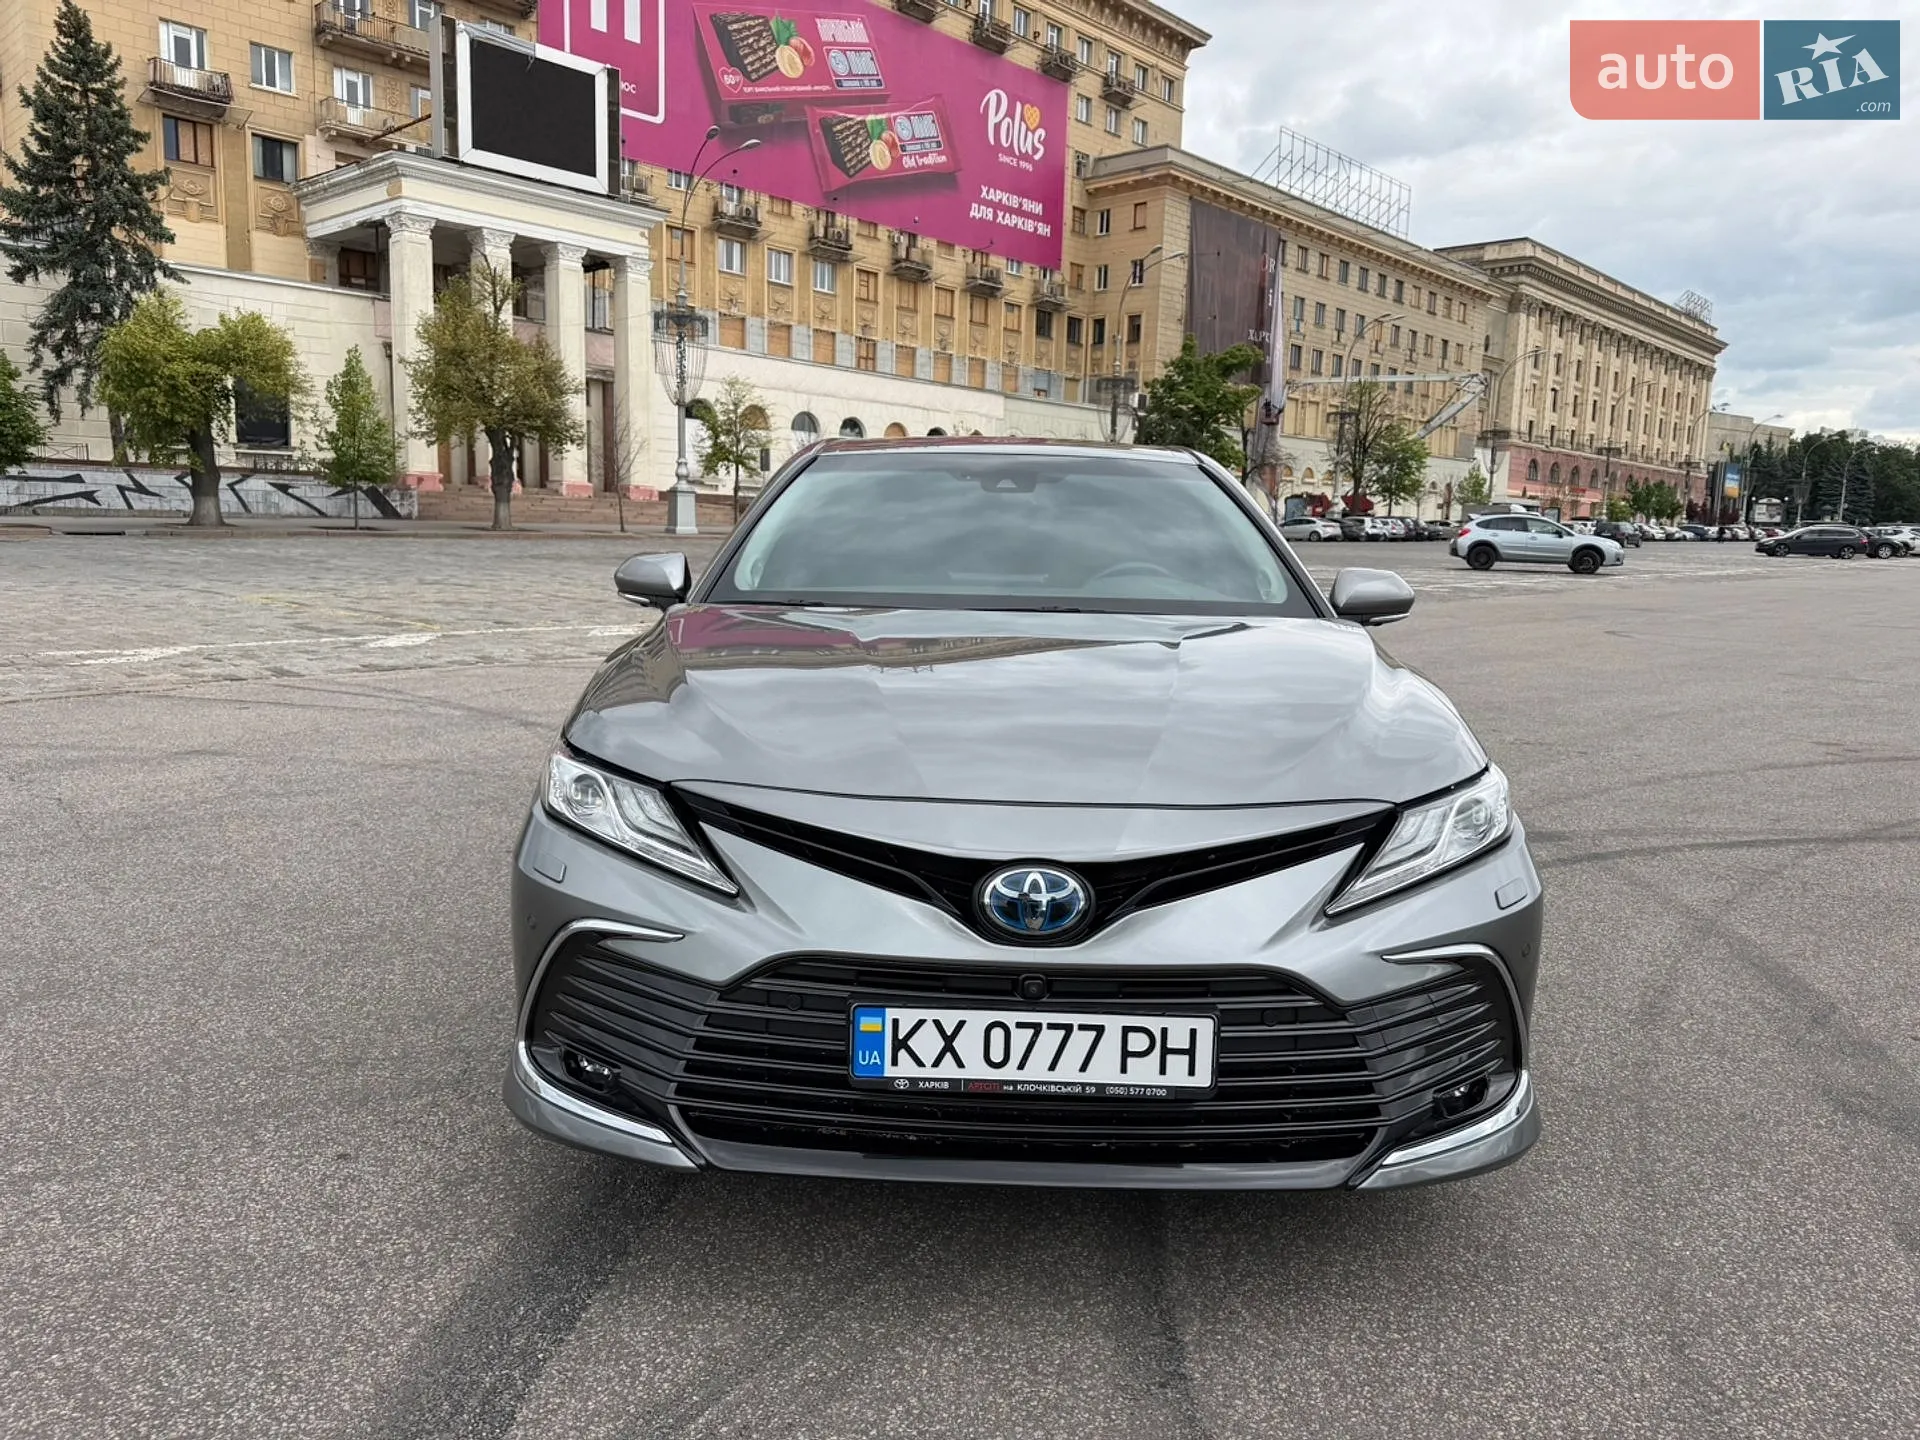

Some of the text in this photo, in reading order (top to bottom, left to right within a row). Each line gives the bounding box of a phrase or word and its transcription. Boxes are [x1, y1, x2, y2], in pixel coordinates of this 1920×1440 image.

[979, 88, 1046, 161] Polus
[969, 202, 993, 222] ДЛЯ
[858, 1017, 1198, 1077] UA KX 0777 PH
[918, 1081, 950, 1089] ХАРКІВ
[1085, 1086, 1096, 1094] 59
